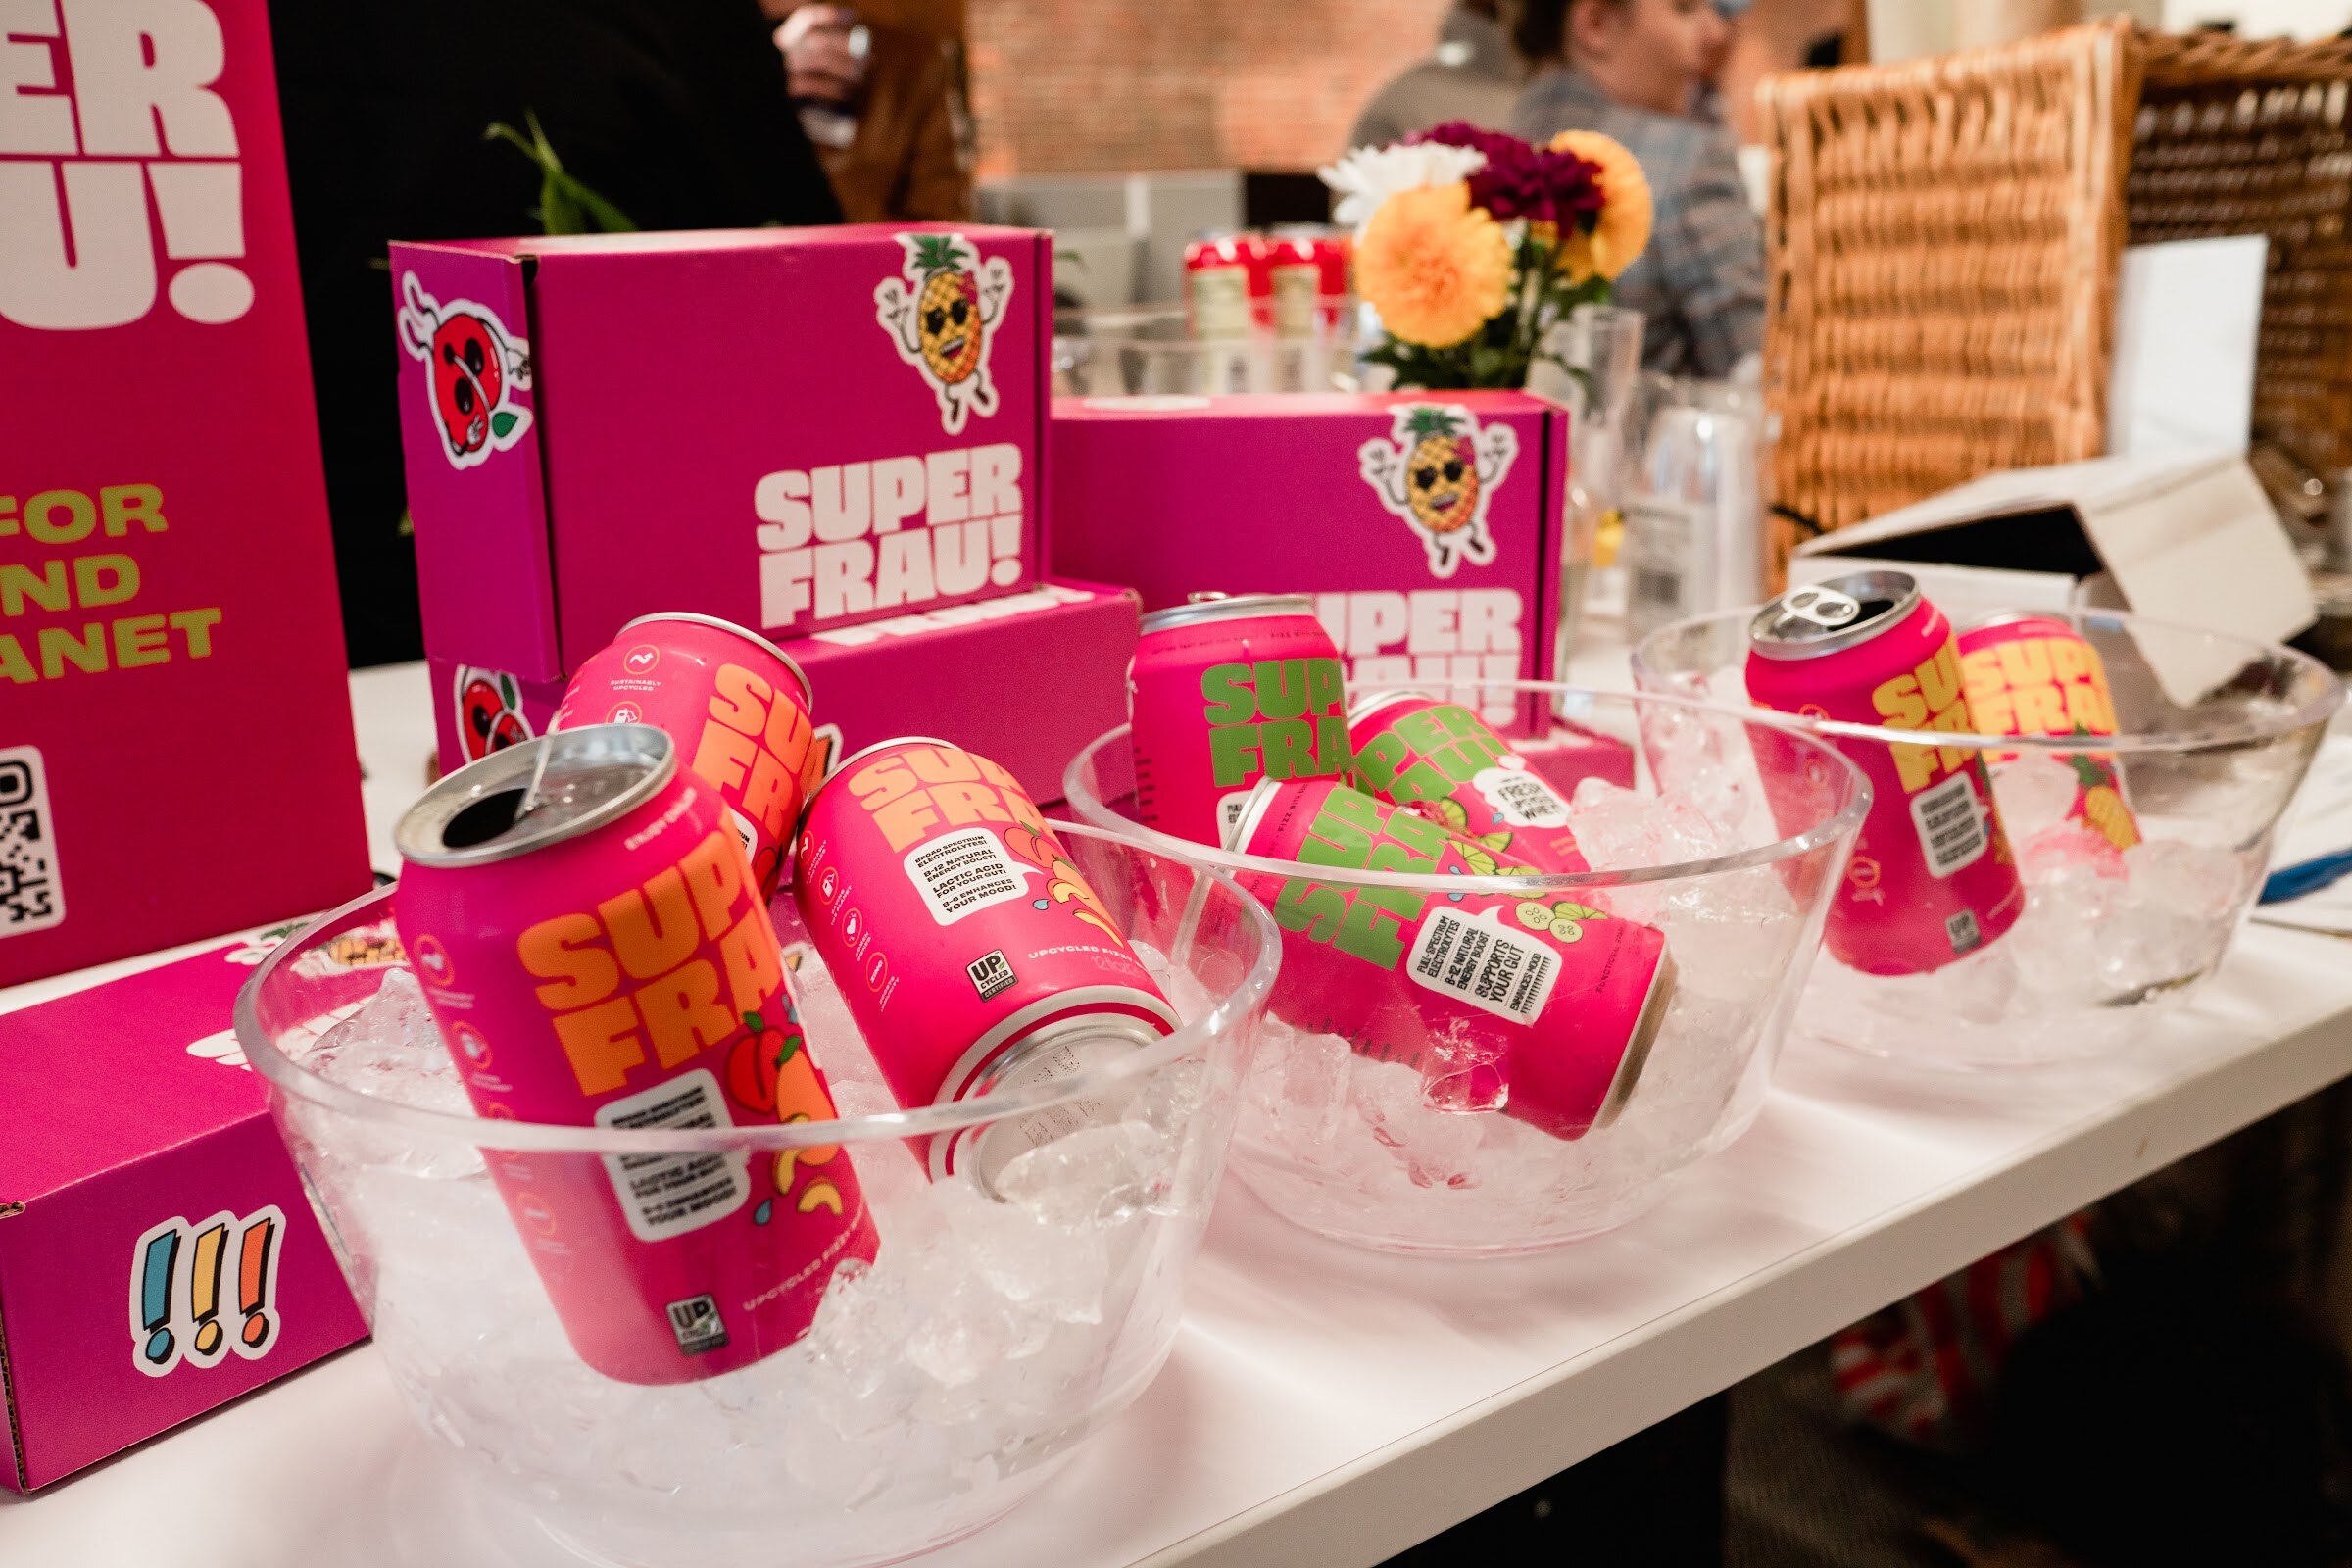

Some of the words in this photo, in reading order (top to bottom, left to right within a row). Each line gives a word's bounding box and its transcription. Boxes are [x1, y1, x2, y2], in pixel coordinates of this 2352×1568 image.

[755, 442, 1022, 552] SUPER
[759, 514, 1022, 629] FRAU!
[915, 847, 941, 863] BROAD
[943, 835, 984, 849] SPECTRUM
[917, 840, 988, 868] ELECTROLYTES!
[923, 864, 944, 878] B-12
[946, 849, 994, 866] NATURAL
[927, 862, 962, 882] ENERGY
[964, 855, 997, 866] BOOST!
[933, 870, 973, 893] LACTIC
[976, 863, 1004, 874] ACID
[937, 885, 956, 898] FOR
[957, 874, 984, 888] YOUR
[984, 868, 1007, 879] GUT!
[946, 896, 977, 913] YOUR
[978, 884, 1017, 899] MOOD!
[960, 878, 1013, 898] ENHANCES
[1028, 945, 1100, 959] UPCYCLED
[1417, 915, 1449, 973] FULL-SPECTRUM
[1427, 919, 1460, 978] ELECTROLYTES
[1445, 964, 1461, 986] B-12
[1454, 927, 1480, 965] NATURAL
[970, 955, 1002, 982] UP
[1456, 956, 1478, 990] ENERGY
[1470, 931, 1490, 959] BOOST
[1475, 939, 1509, 998] SUPPORTS
[1489, 967, 1515, 1003] YOUR
[1504, 945, 1525, 972] GUT
[980, 969, 1009, 990] CYCLED
[984, 978, 1013, 998] CERTIFIED
[1510, 972, 1533, 1011] ENHANCES
[1527, 953, 1542, 974] MOOD
